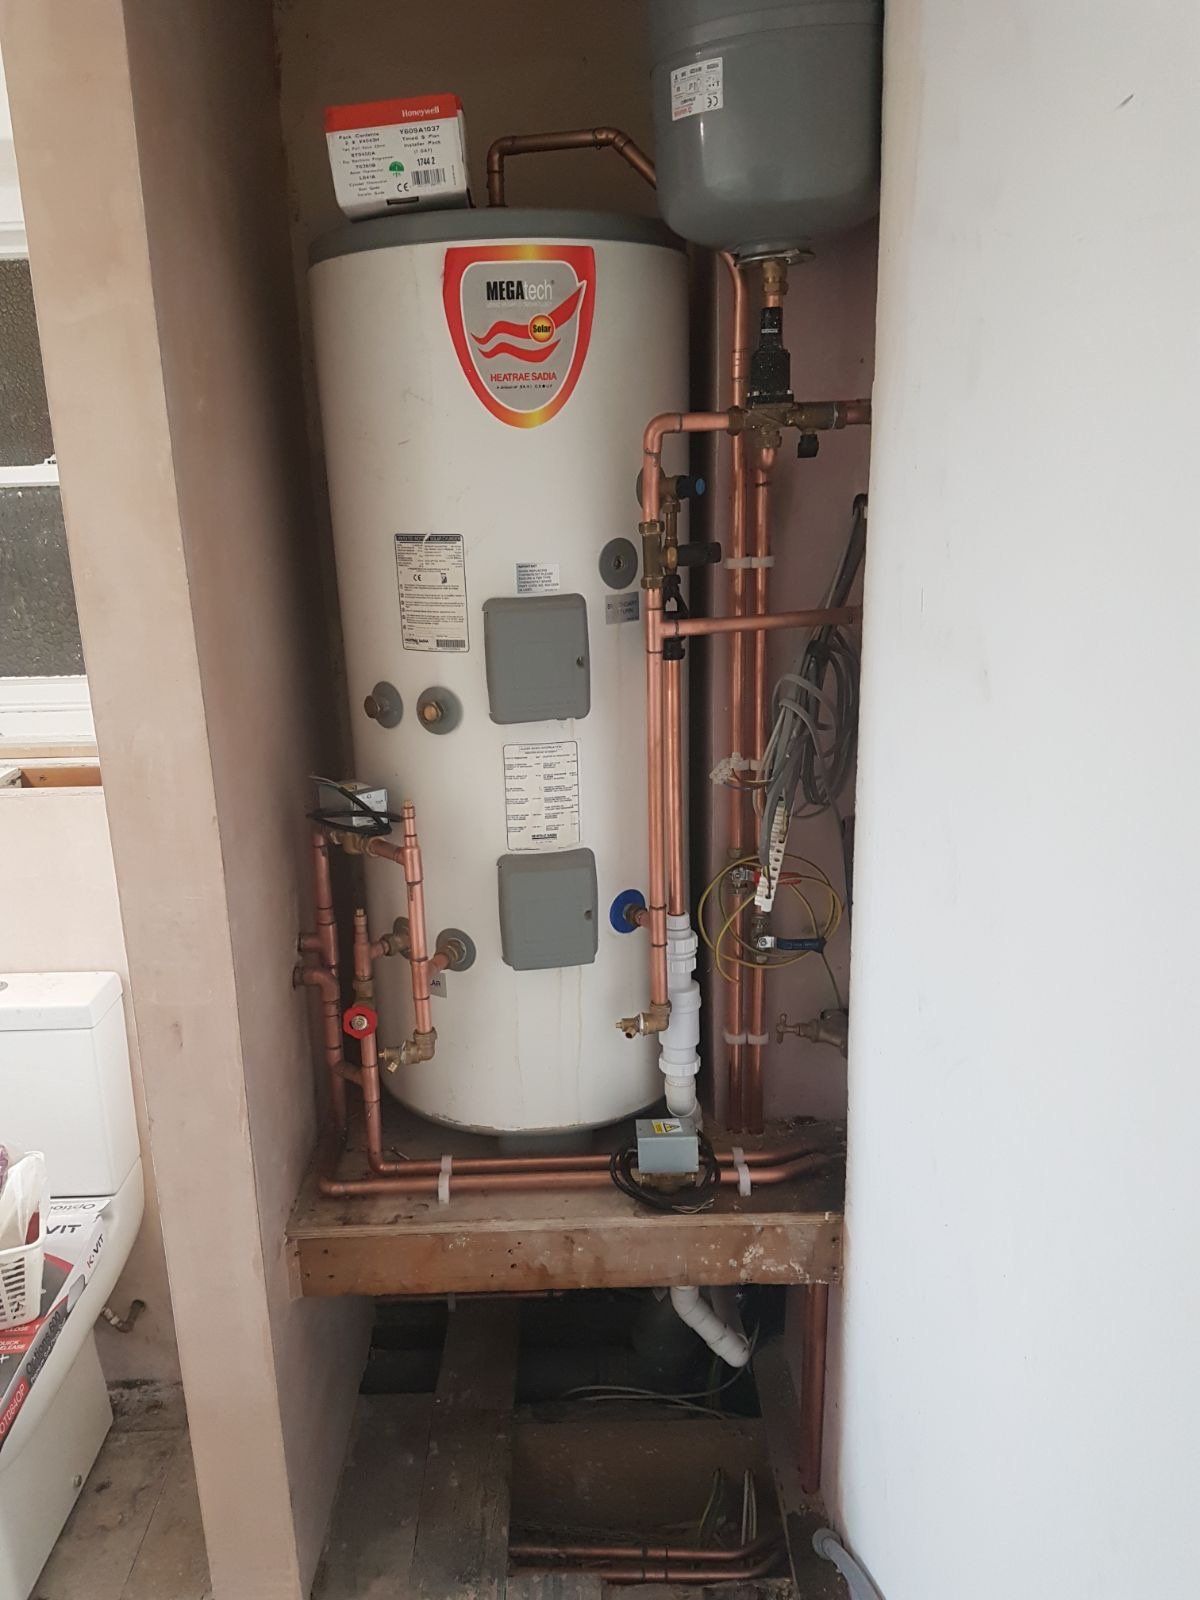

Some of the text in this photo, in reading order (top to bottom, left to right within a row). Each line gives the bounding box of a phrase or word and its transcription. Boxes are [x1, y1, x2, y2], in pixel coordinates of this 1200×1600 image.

[402, 106, 440, 118] Honeywell
[400, 125, 440, 134] Y609A1037
[417, 156, 436, 166] 1744 2
[532, 324, 551, 333] Solar
[490, 371, 558, 382] HEATRAE SADIA
[48, 1310, 60, 1332] 600
